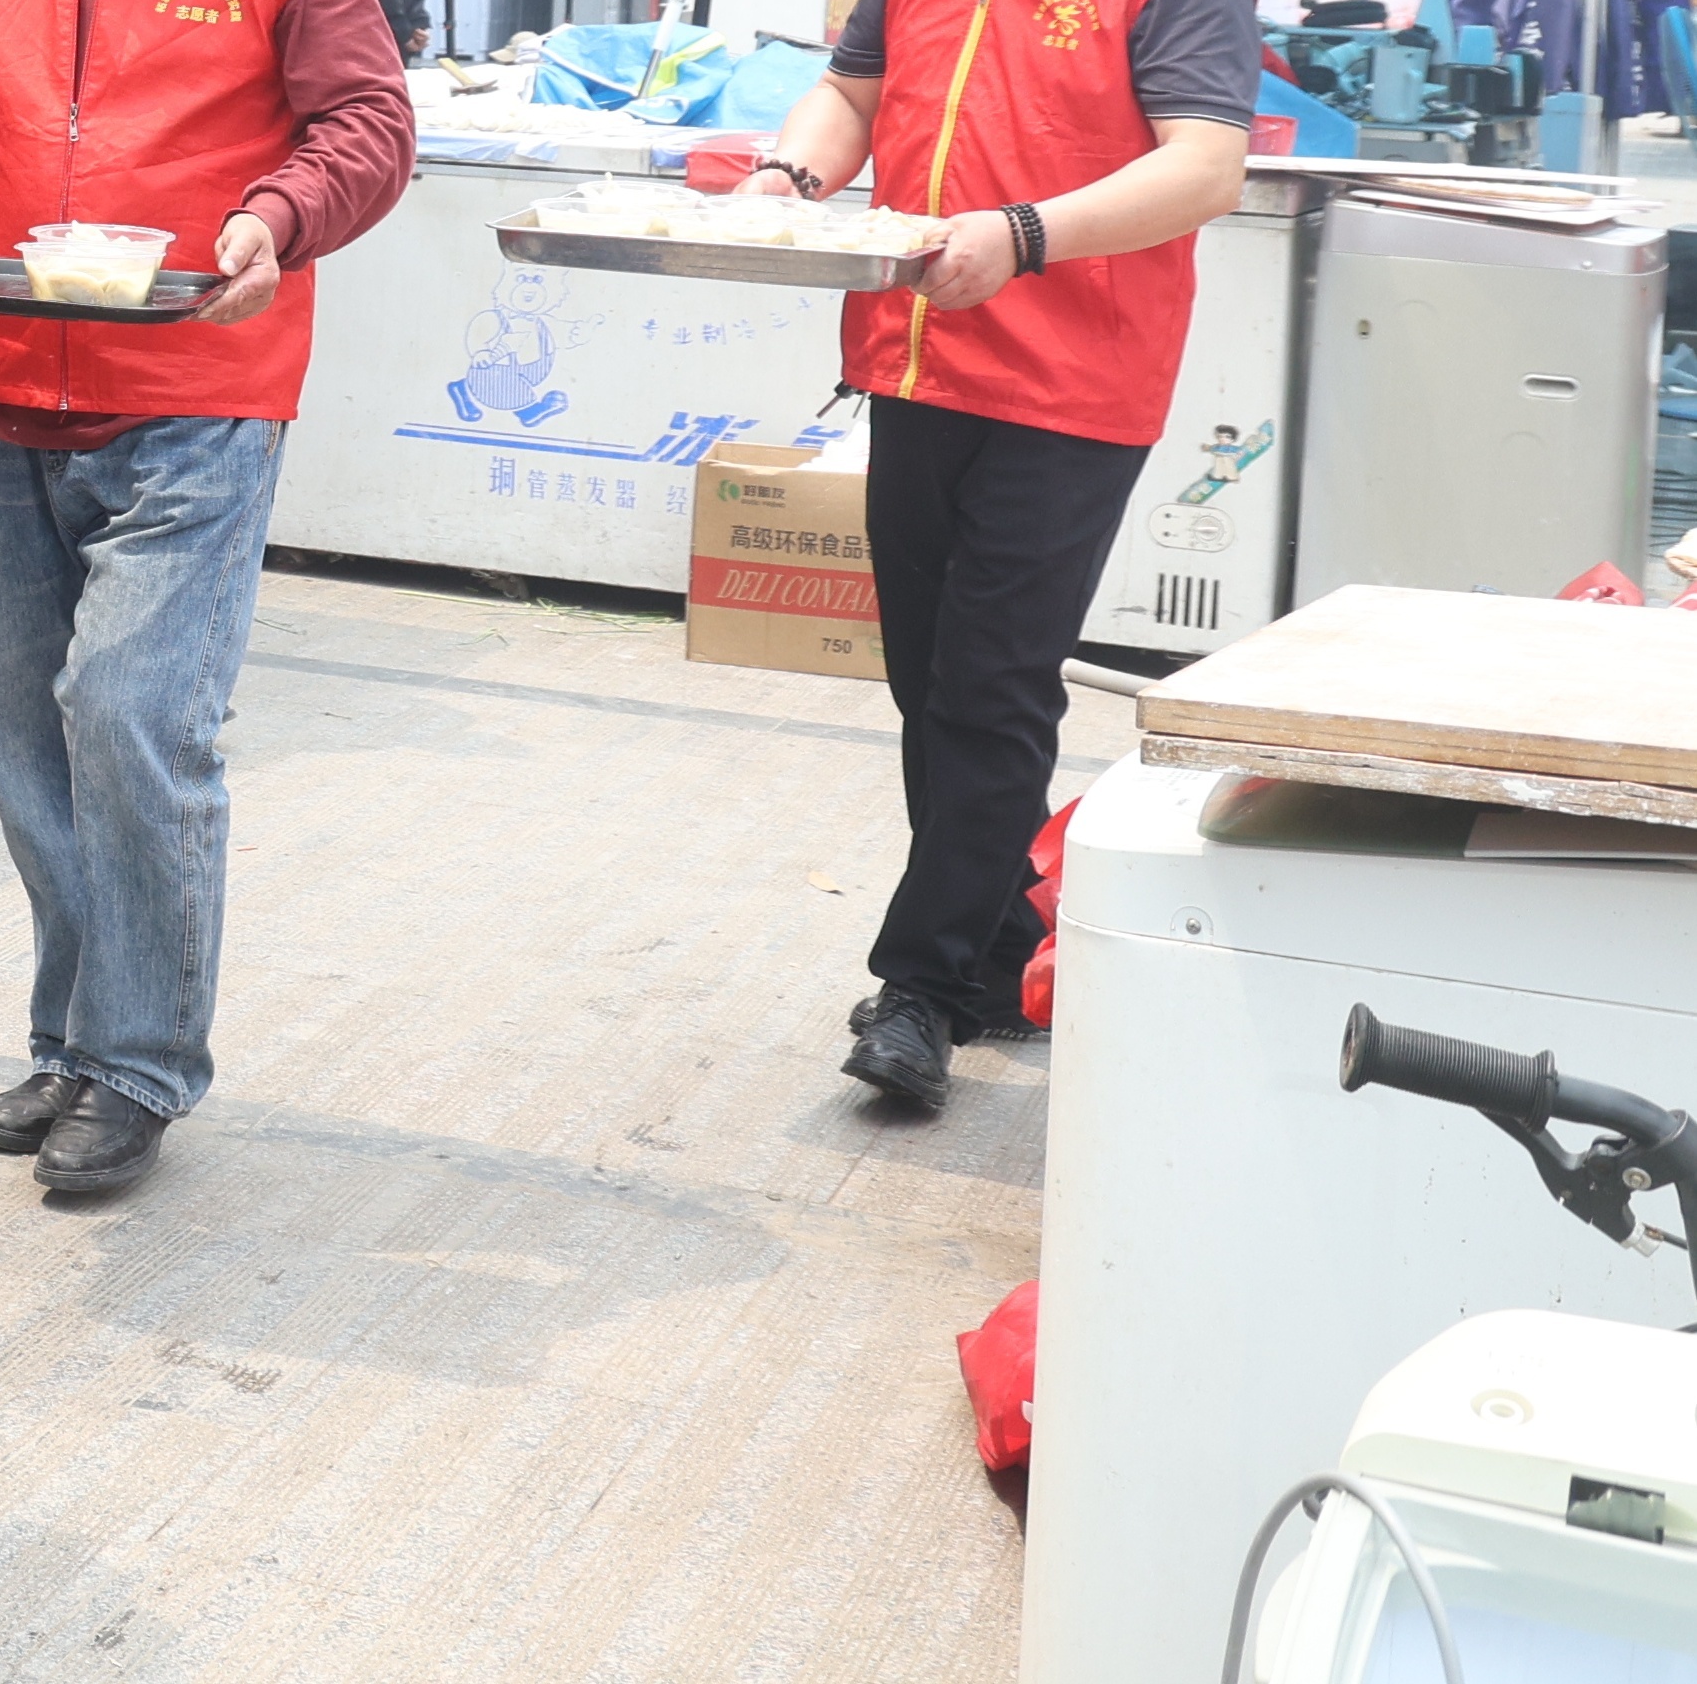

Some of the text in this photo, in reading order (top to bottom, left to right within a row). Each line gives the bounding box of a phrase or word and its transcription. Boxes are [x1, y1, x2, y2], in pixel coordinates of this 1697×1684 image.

[175, 5, 219, 24] 志愿者
[489, 456, 636, 510] 铜管蒸发器
[717, 569, 881, 614] DELI CONTAI
[821, 637, 853, 655] 750
